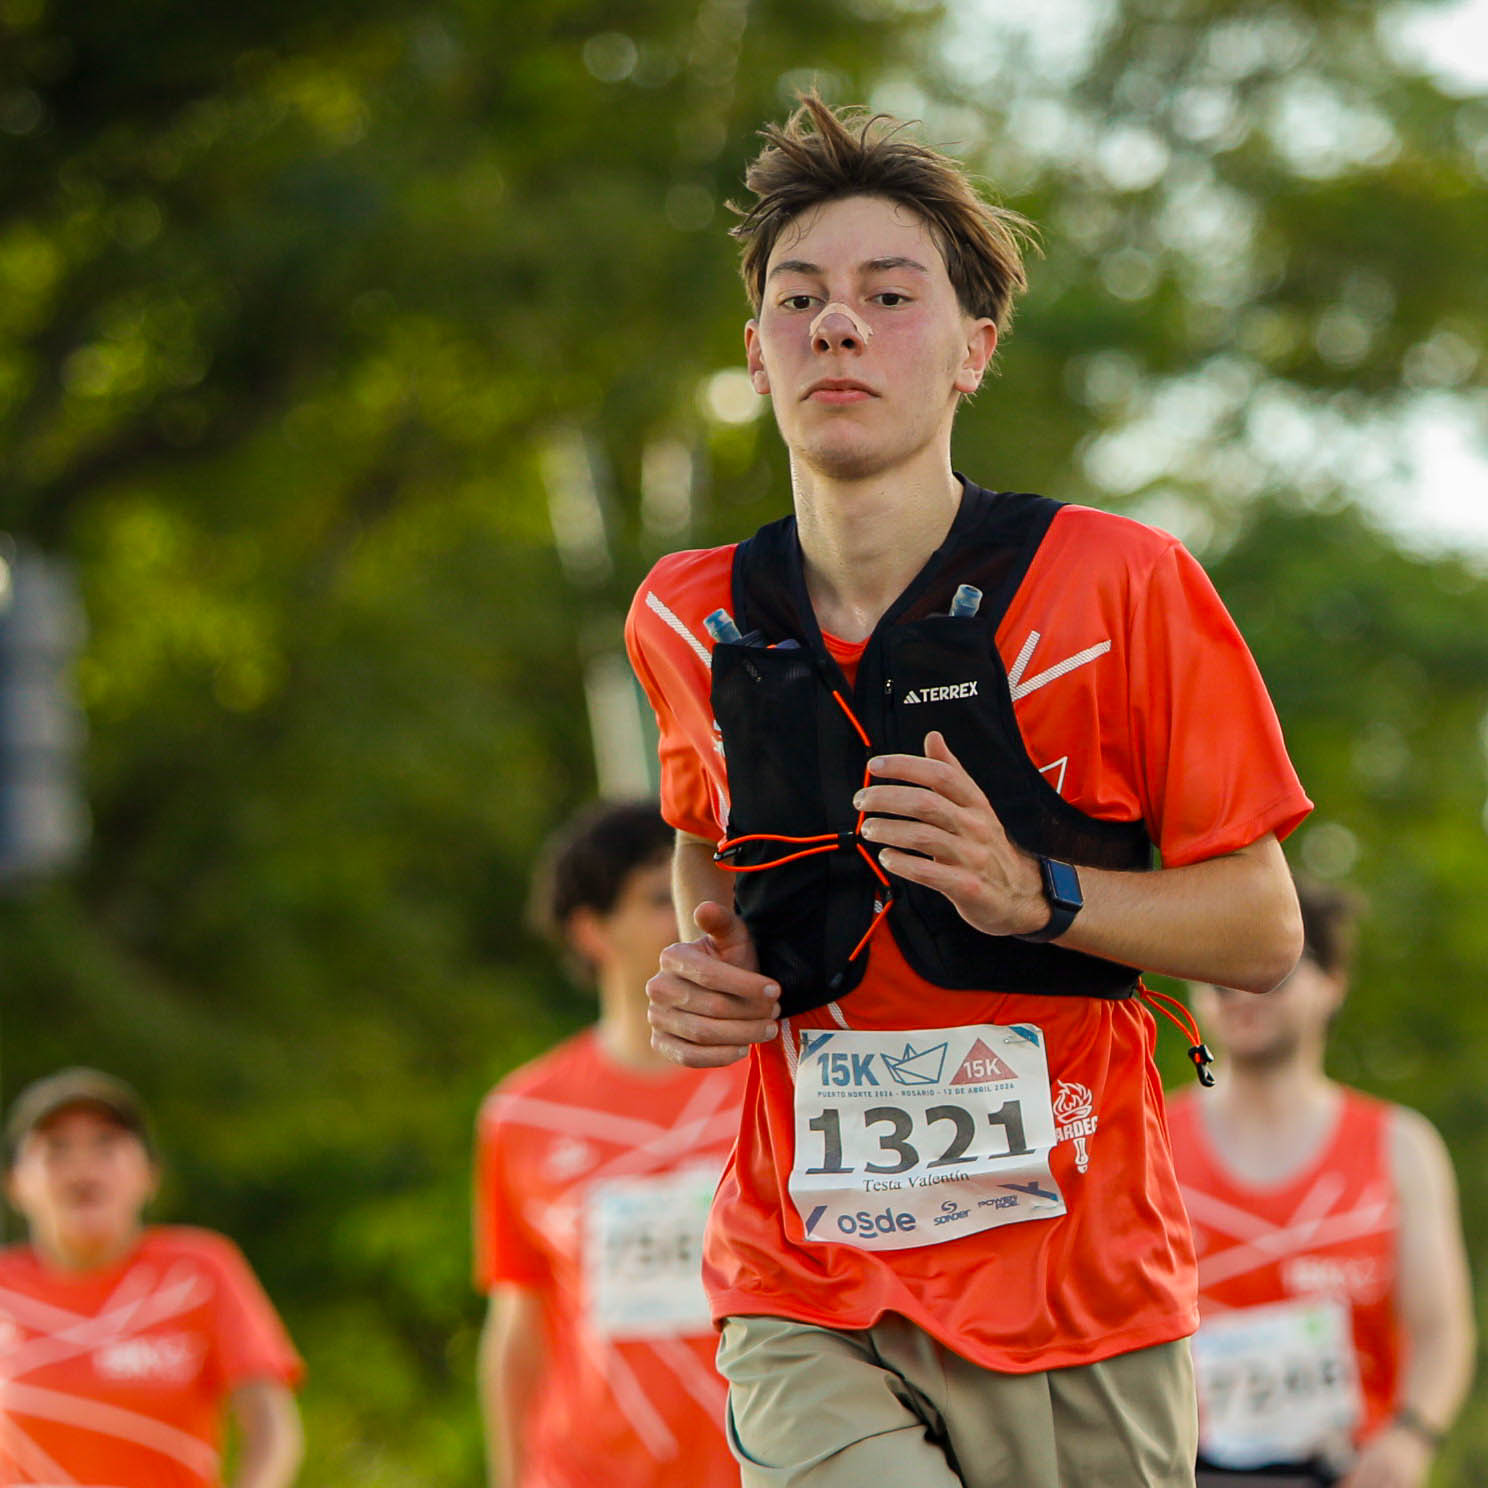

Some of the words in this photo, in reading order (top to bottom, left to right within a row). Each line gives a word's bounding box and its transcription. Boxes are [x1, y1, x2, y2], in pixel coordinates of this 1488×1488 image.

[920, 681, 978, 702] TERREX
[817, 1052, 880, 1087] 15K
[963, 1058, 1002, 1079] 15K
[817, 1090, 846, 1098] PUERTO
[847, 1090, 873, 1098] NORTE
[901, 1089, 935, 1097] ROSARIO
[968, 1085, 992, 1094] ABRIL
[805, 1100, 1037, 1175] 1321
[863, 1178, 902, 1192] Testa
[837, 1207, 916, 1236] osde
